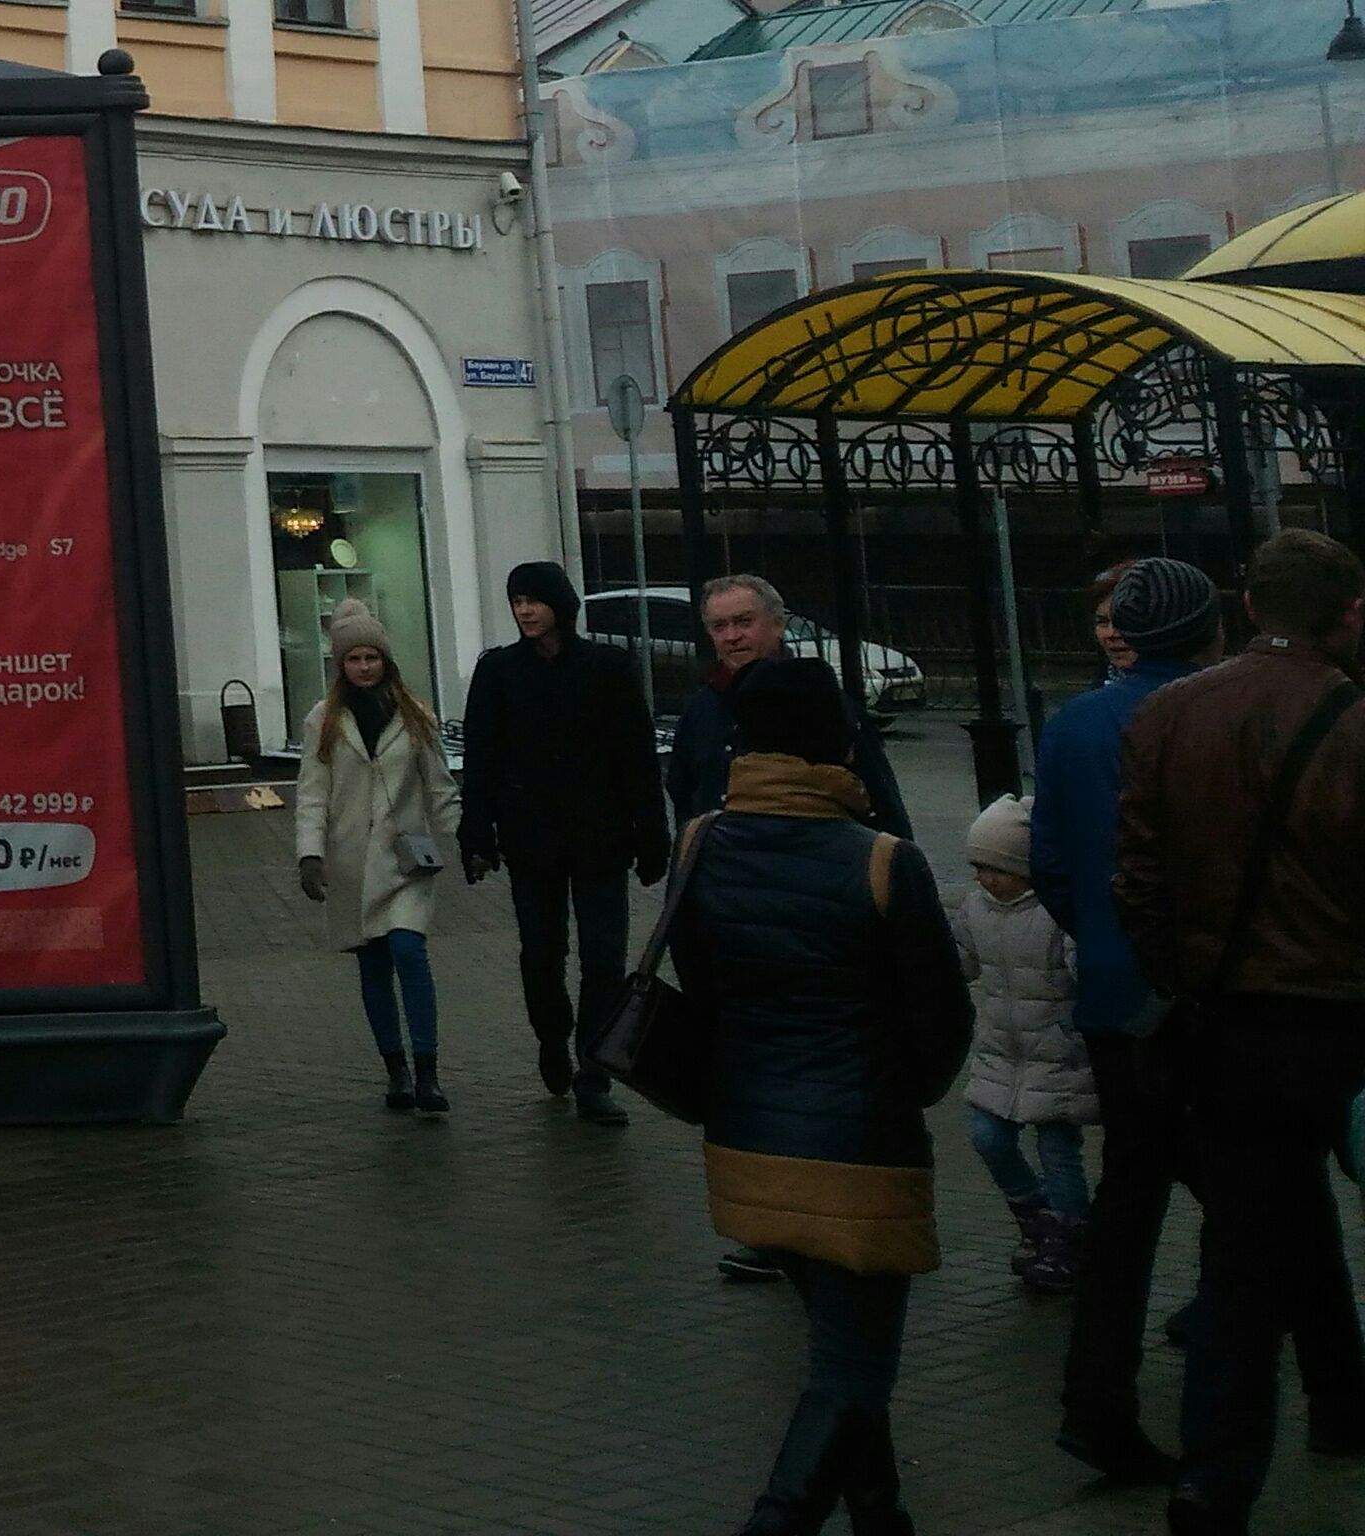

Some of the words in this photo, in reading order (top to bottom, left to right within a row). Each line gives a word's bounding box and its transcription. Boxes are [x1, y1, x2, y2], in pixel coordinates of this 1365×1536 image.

[310, 200, 483, 250] ЛЮСТРЫ
[520, 362, 534, 382] 47
[49, 537, 75, 556] S7
